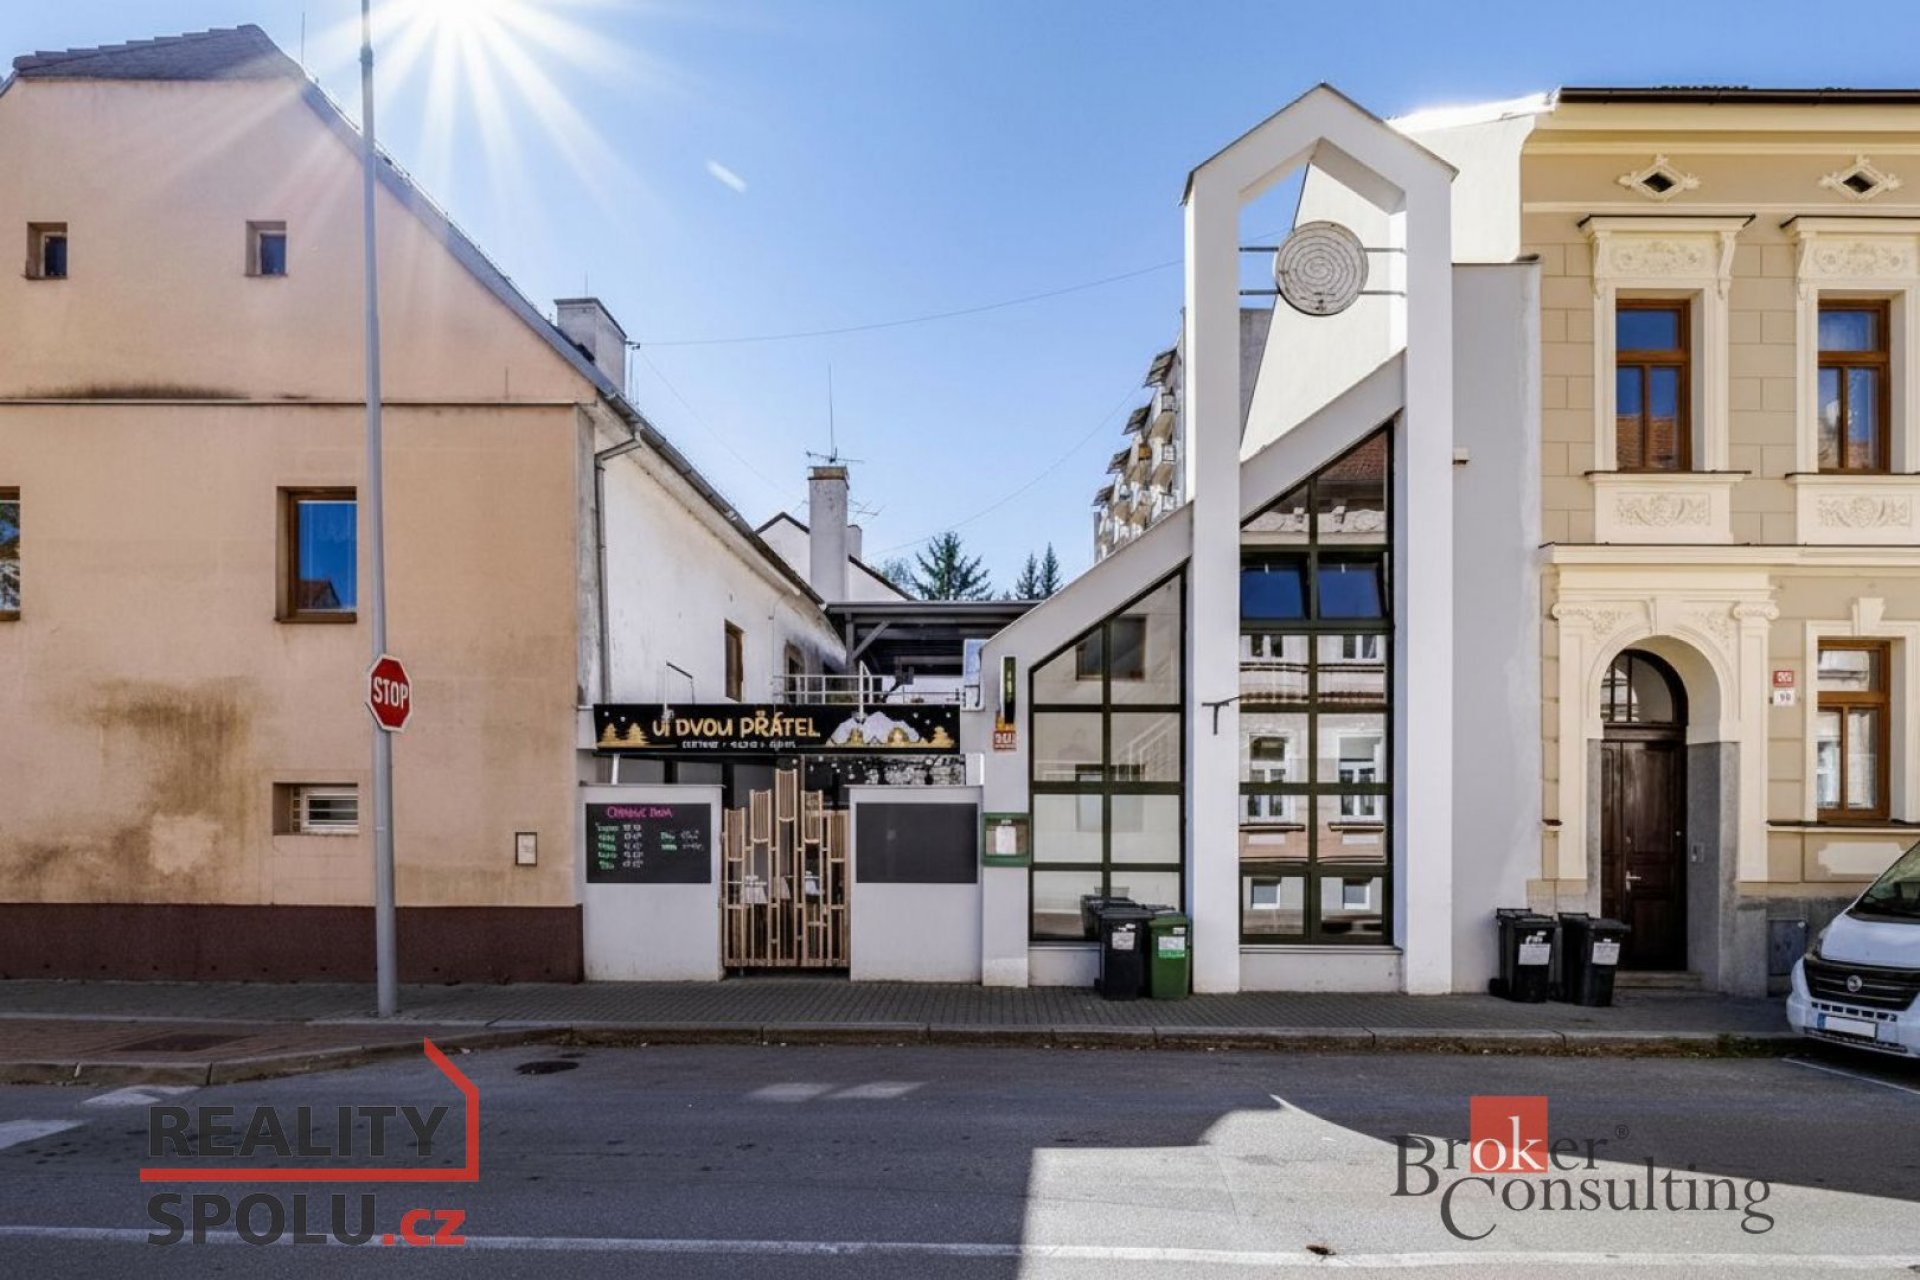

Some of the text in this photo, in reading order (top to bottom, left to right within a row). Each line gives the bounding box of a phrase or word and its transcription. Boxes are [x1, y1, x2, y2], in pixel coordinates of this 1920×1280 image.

[373, 676, 409, 710] STOP
[676, 717, 733, 737] DVOU
[740, 710, 820, 738] PŘÁTEL
